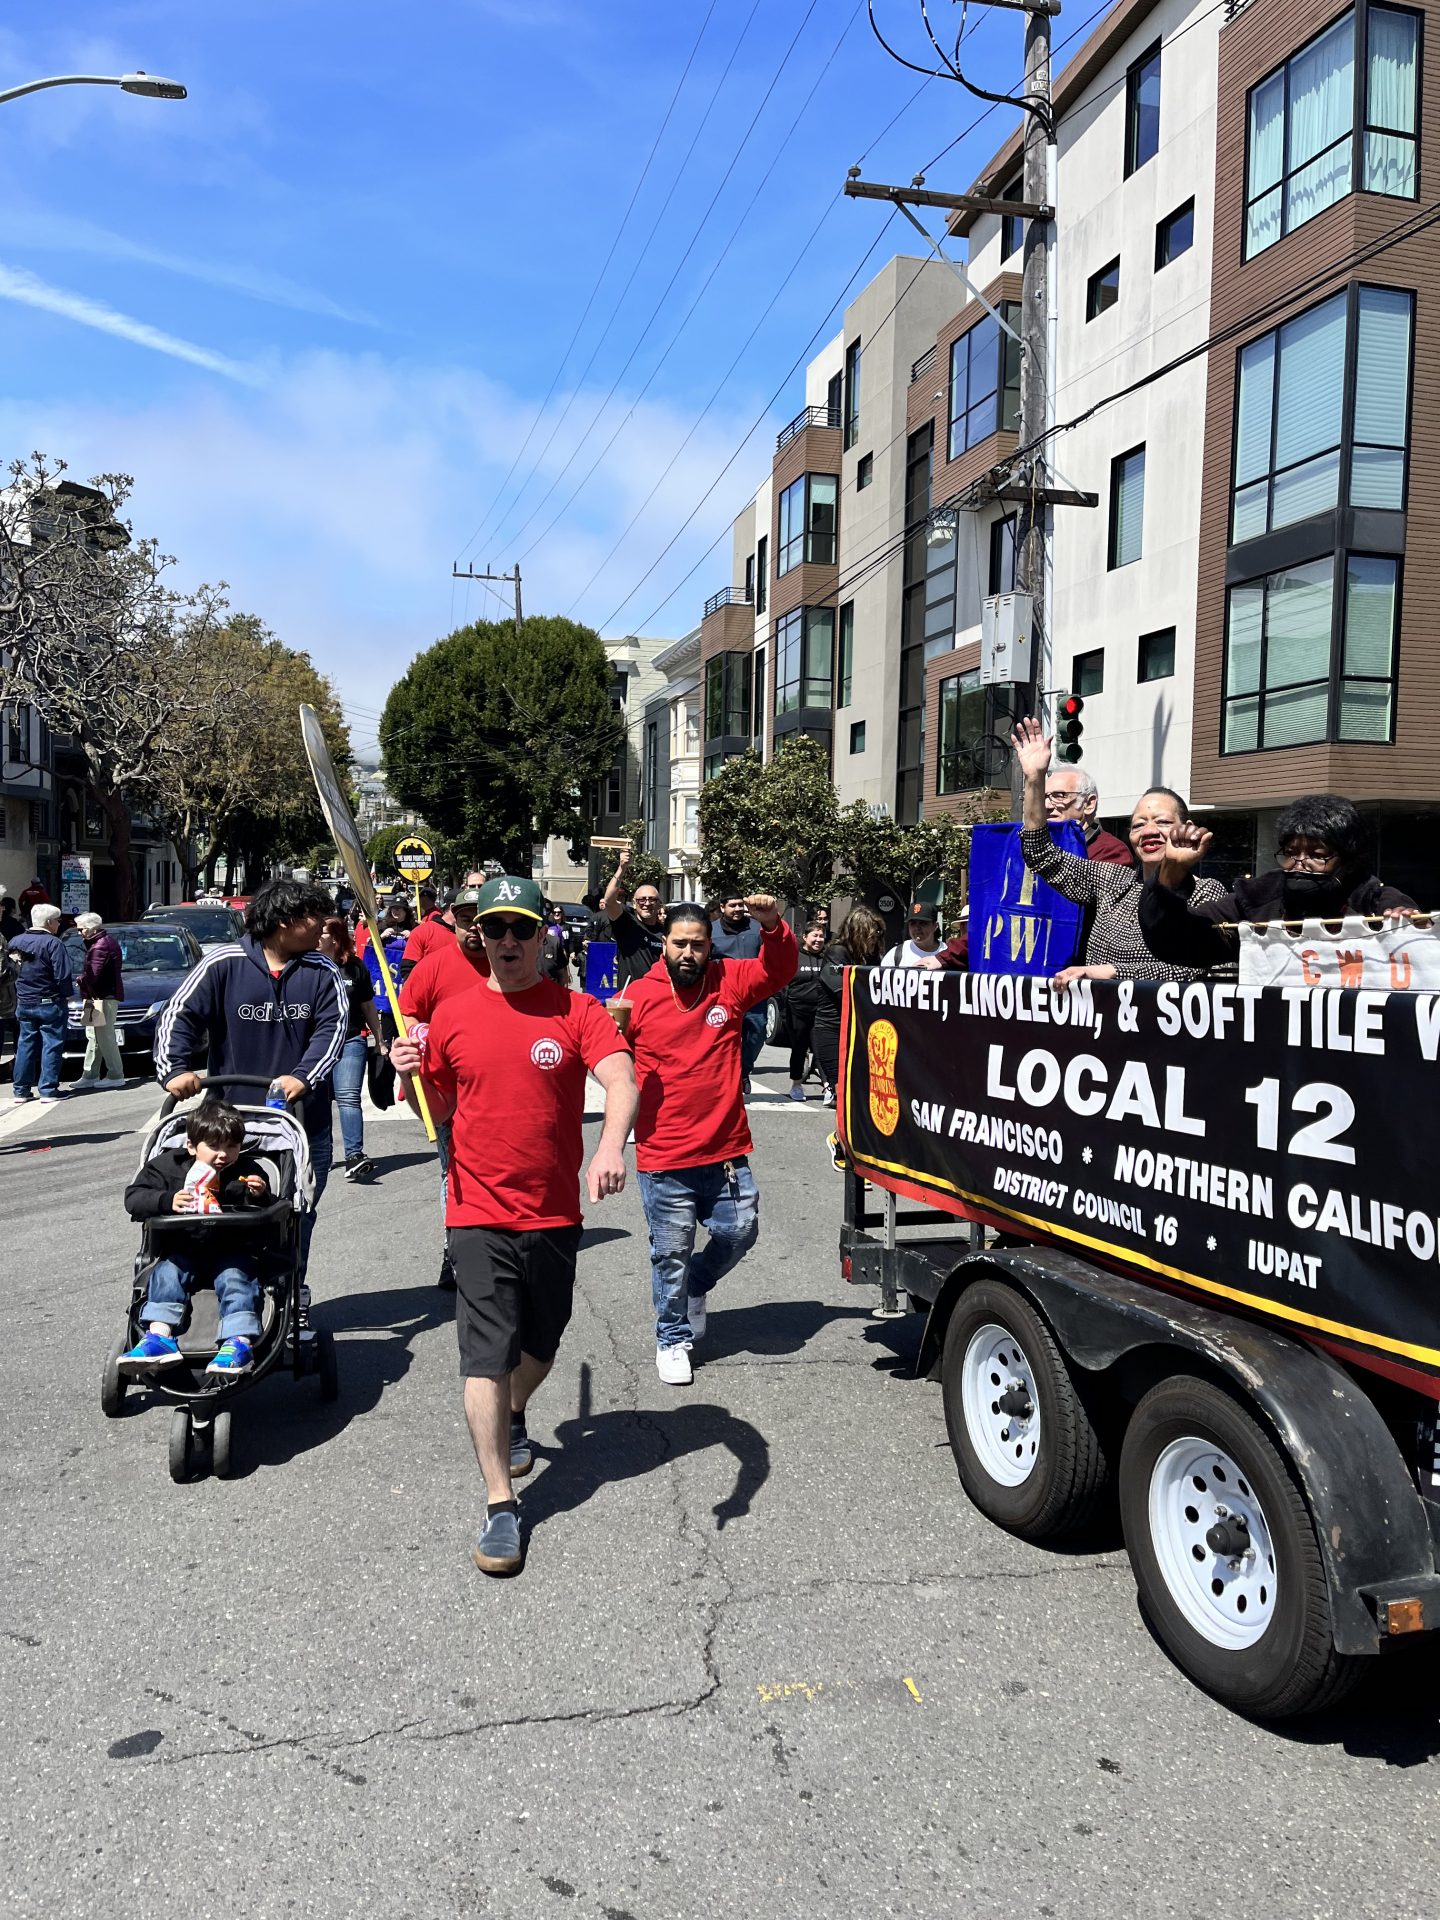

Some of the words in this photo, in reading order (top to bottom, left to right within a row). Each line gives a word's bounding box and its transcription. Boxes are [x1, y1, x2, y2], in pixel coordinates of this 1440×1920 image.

[493, 880, 521, 902] A's
[868, 967, 949, 1022] CARPET,
[959, 972, 1103, 1040] LINOLEUM,
[1117, 980, 1140, 1033] &
[1156, 981, 1264, 1042] SOFT
[1281, 987, 1392, 1055] TILE
[987, 1044, 1206, 1137] LOCAL
[1244, 1077, 1356, 1165] 12
[911, 1098, 946, 1134] SAN
[948, 1108, 1064, 1165] FRANCISCO
[1113, 1144, 1274, 1220] NORTHERN
[1287, 1183, 1440, 1265] CALIFO
[993, 1166, 1069, 1210] DISTRICT
[1072, 1188, 1147, 1238] COUNCIL
[1153, 1214, 1179, 1247] 16
[1247, 1239, 1323, 1290] IUPAT
